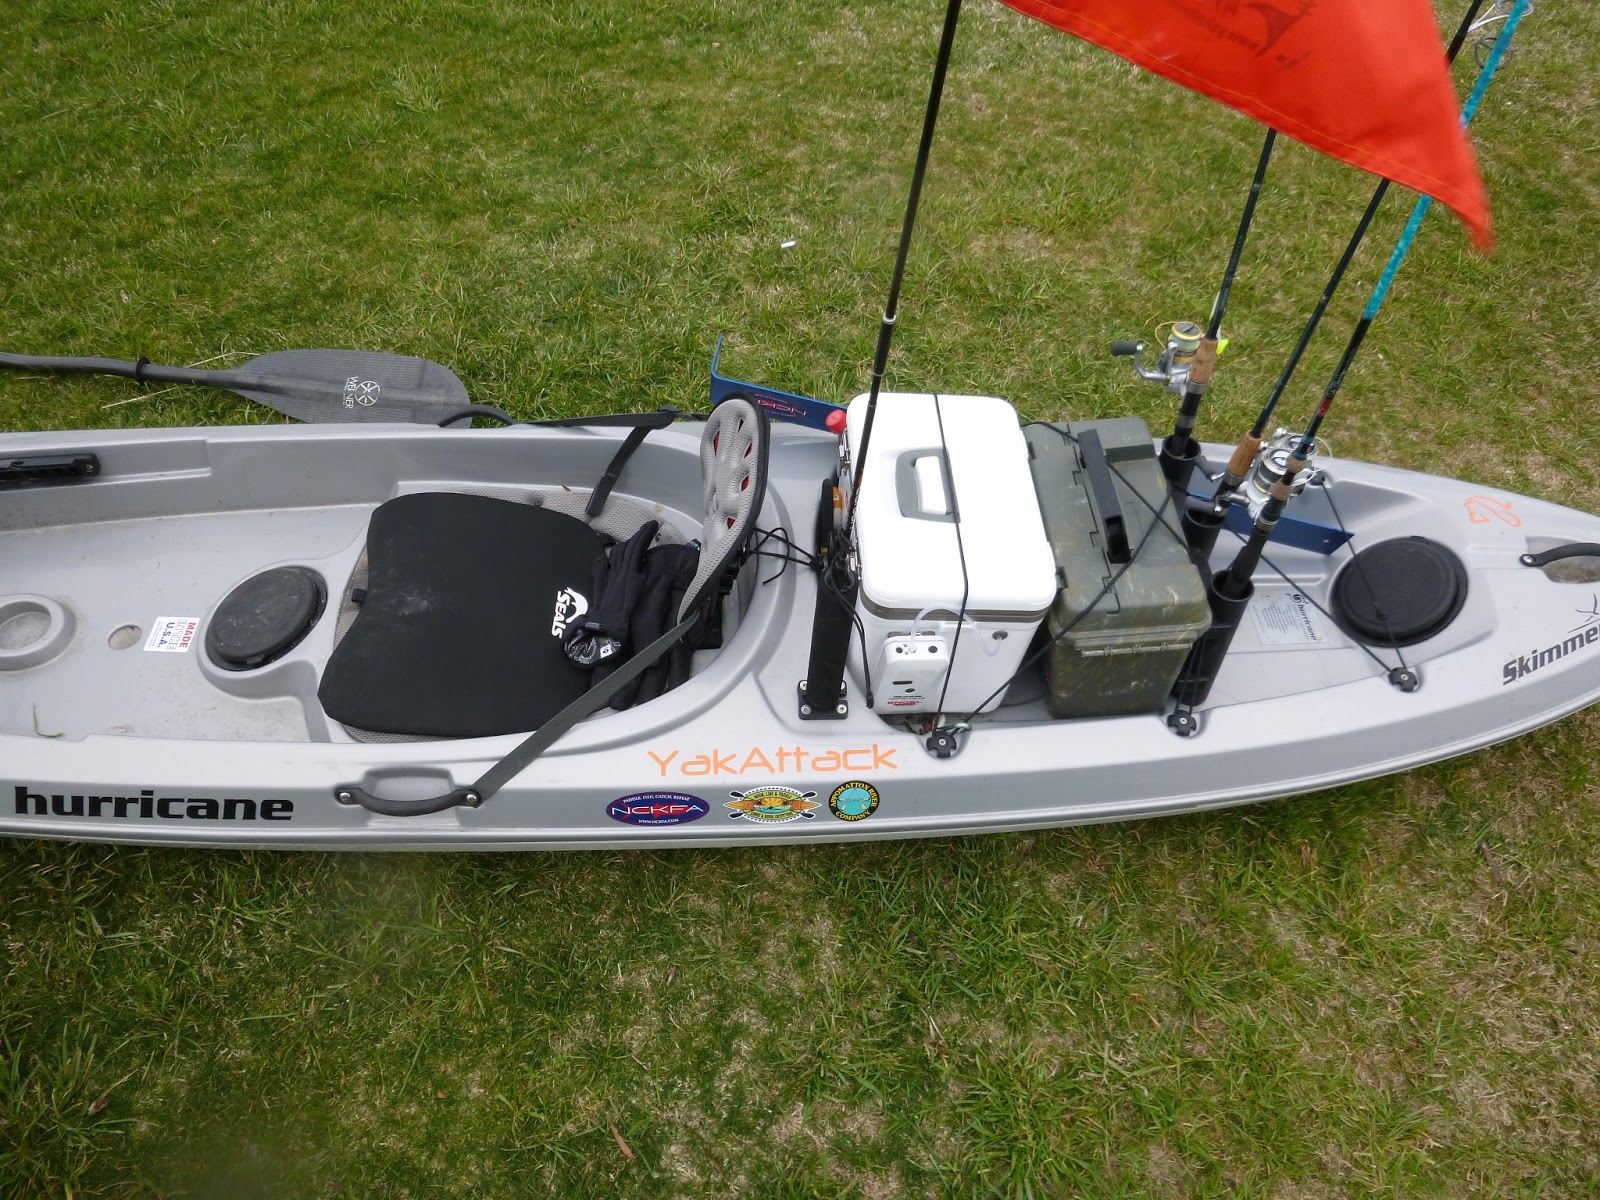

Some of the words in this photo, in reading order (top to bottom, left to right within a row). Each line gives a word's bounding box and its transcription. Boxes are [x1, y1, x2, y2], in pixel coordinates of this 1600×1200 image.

[345, 376, 359, 409] WENER
[174, 619, 188, 631] IN
[551, 590, 571, 639] SEALS
[157, 622, 175, 648] U.S.A.
[166, 630, 183, 650] THE
[179, 622, 197, 648] MADE
[1502, 624, 1600, 686] Skimme
[648, 744, 898, 776] YakAttack
[14, 786, 294, 821] hurricane
[830, 782, 870, 807] APPOMATTOX
[868, 788, 878, 807] RIVER
[611, 805, 704, 816] NCKFA
[835, 810, 871, 821] COMPANY
